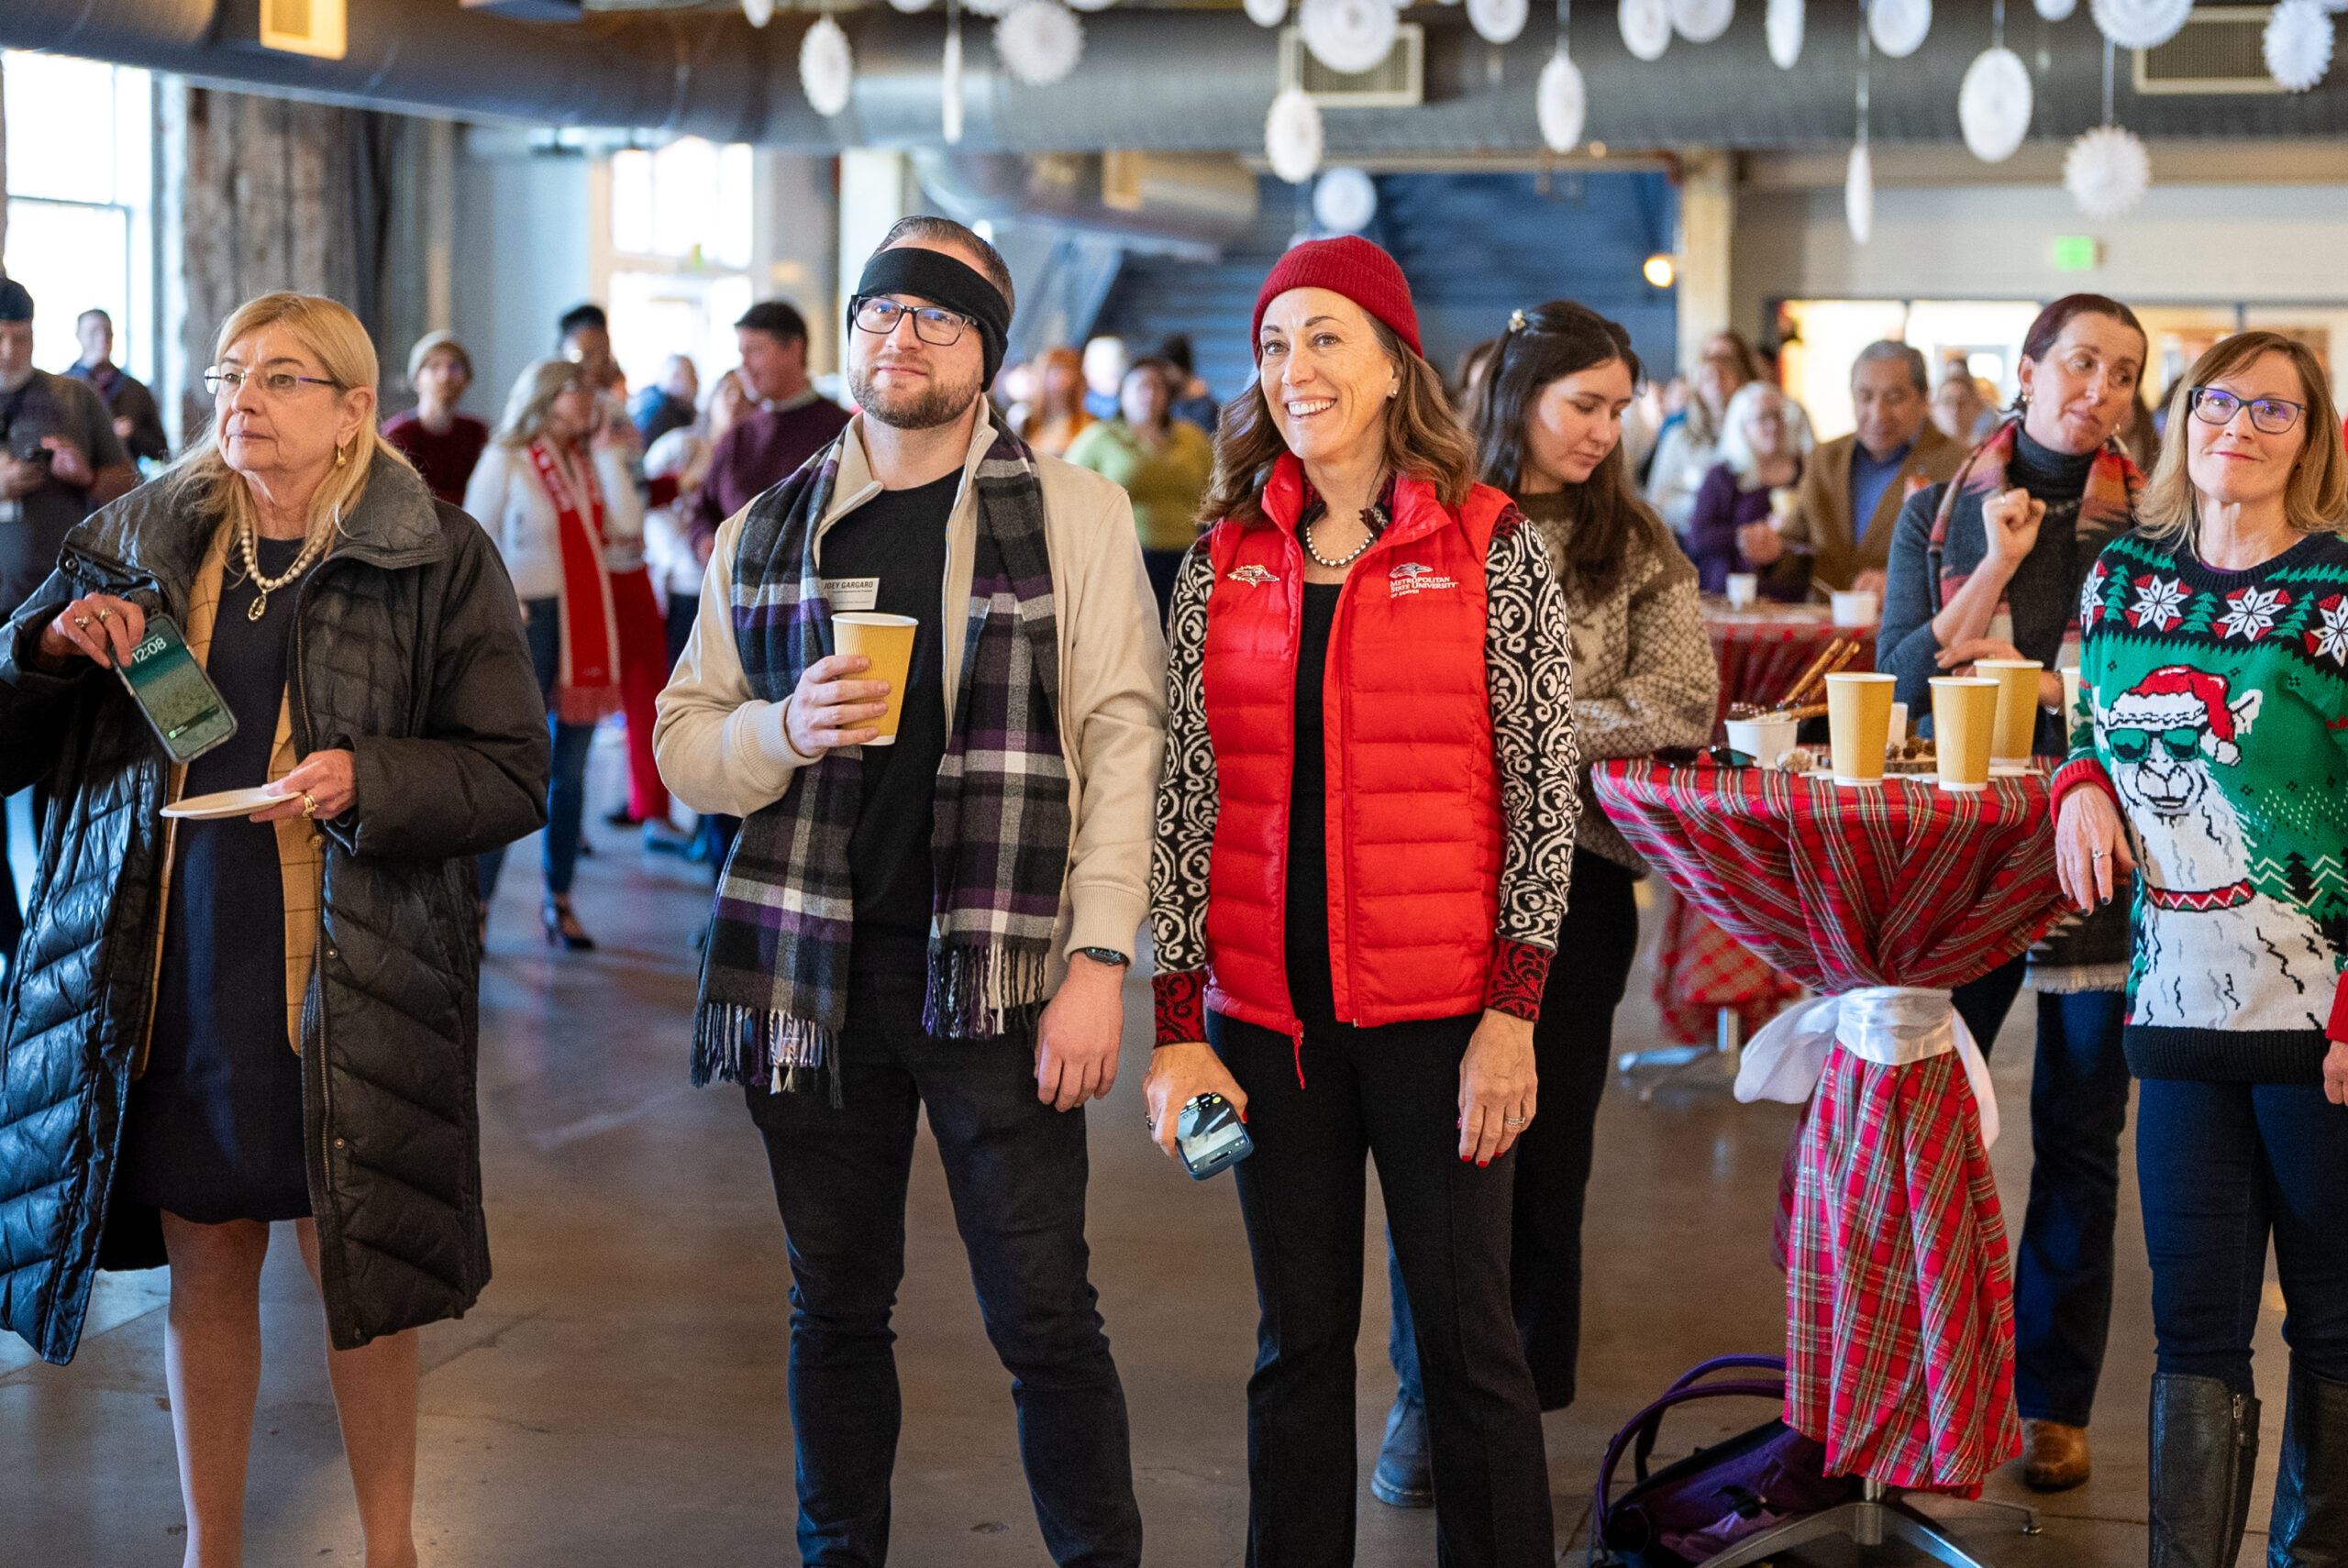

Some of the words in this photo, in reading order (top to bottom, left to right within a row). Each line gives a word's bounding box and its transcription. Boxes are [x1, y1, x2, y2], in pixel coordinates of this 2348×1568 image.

[825, 581, 840, 590] JOEY
[1390, 577, 1450, 587] METROPOLITAN
[1390, 584, 1410, 593] STATE
[1412, 581, 1458, 590] UNIVERSITY
[131, 637, 167, 663] 12:08
